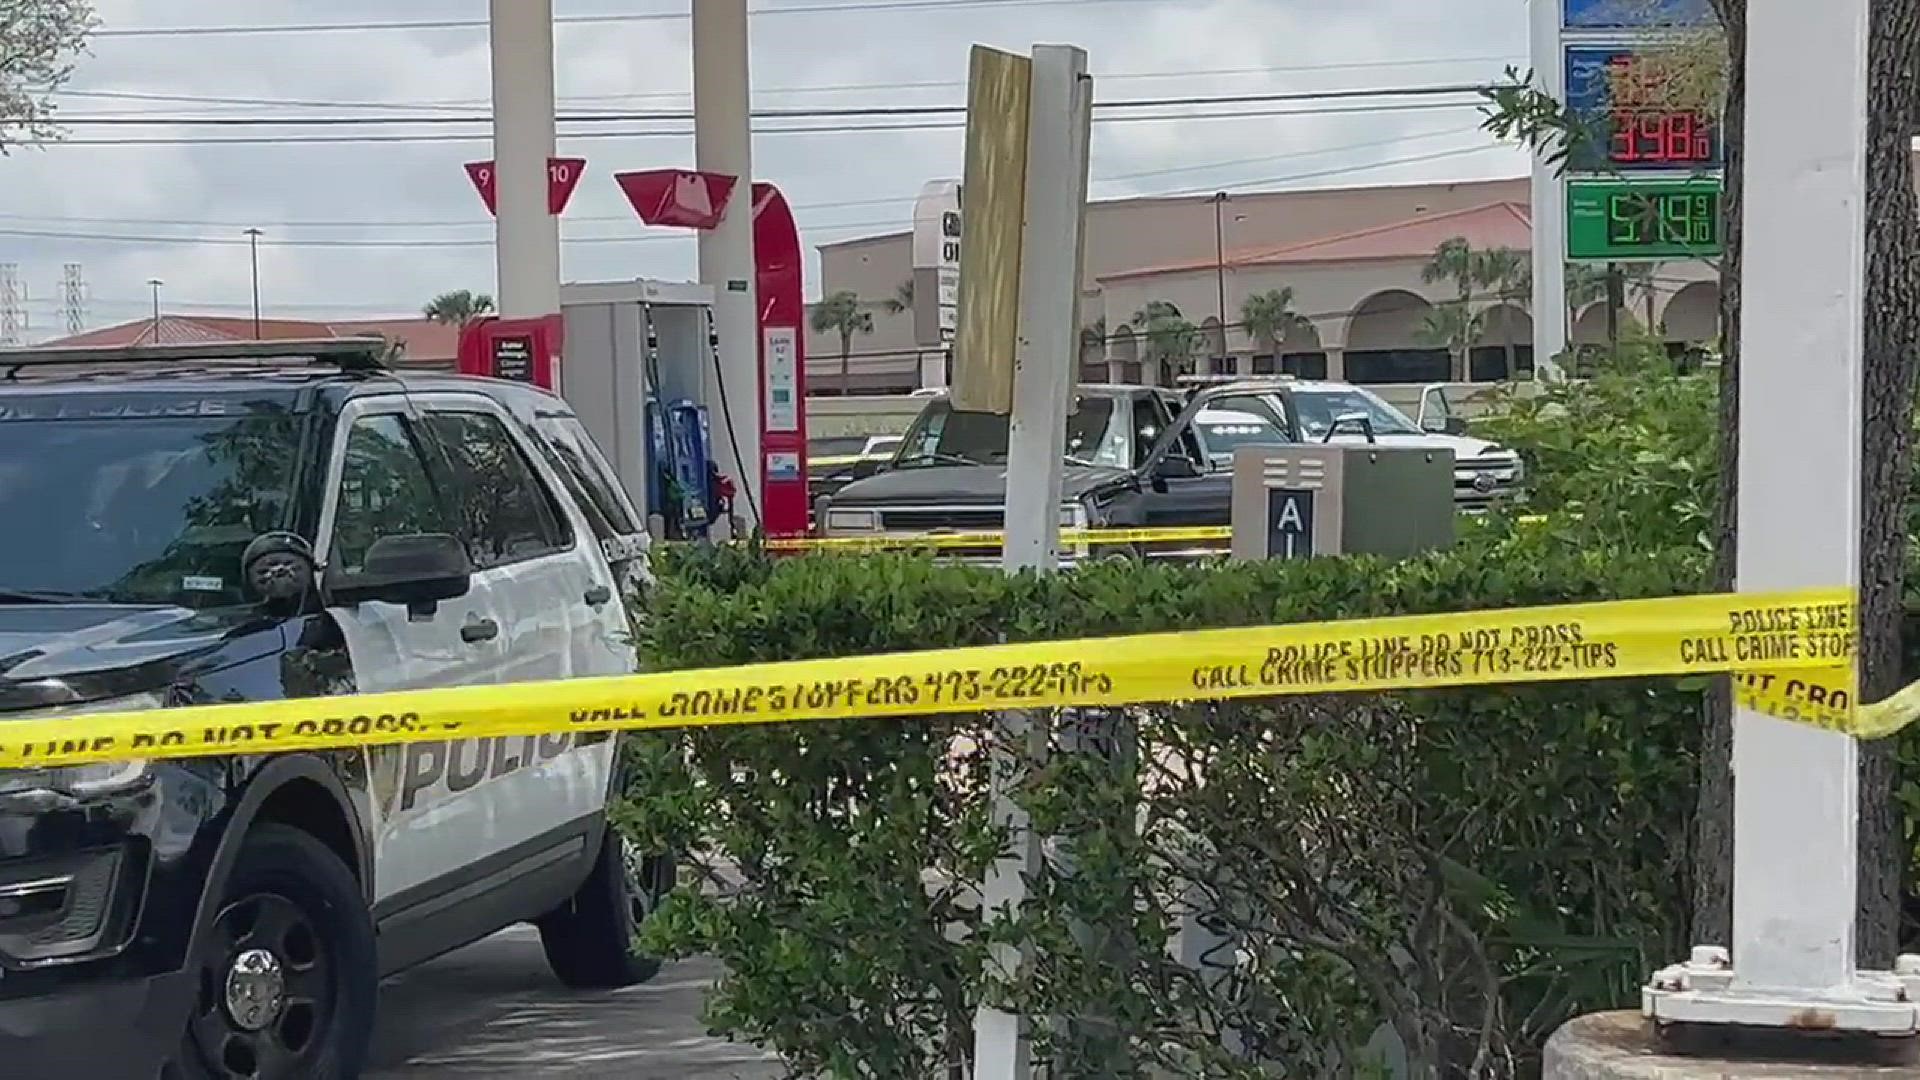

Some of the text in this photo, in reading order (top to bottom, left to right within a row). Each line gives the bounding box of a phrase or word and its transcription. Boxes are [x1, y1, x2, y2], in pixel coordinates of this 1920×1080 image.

[478, 168, 490, 186] 9
[550, 166, 569, 183] 10
[1729, 604, 1847, 634] POLICE LINE
[1267, 640, 1352, 664] POLICE
[1421, 634, 1450, 651] DO
[1459, 628, 1500, 649] NOT
[1510, 622, 1583, 647] CROSS
[1681, 638, 1728, 664] CALL
[1735, 636, 1799, 661] CRIME
[1193, 642, 1617, 689] CALL CRIME STOPPERS 713-222-TIPS
